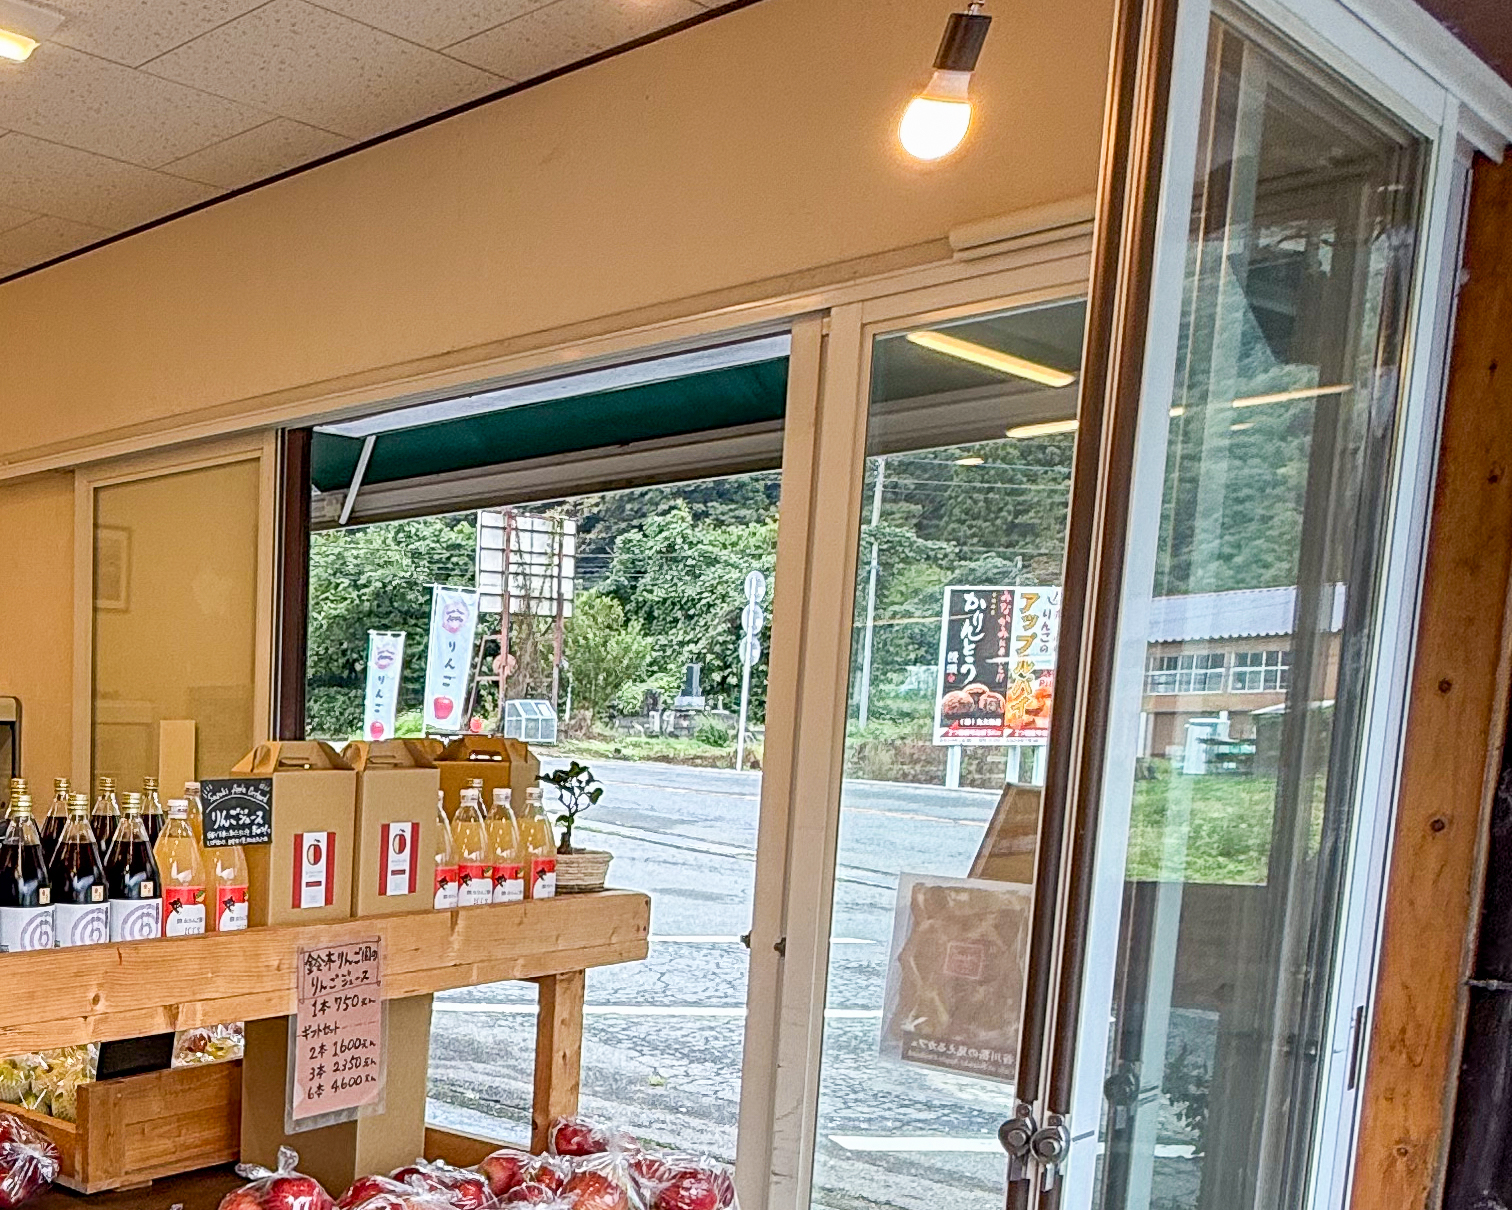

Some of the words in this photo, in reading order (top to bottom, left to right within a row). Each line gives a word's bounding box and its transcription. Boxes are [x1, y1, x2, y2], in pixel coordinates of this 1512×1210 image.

[960, 591, 987, 685] かりんとう
[442, 641, 456, 687] りんご
[1011, 592, 1040, 718] アップルパイ
[374, 675, 386, 713] りんご
[211, 808, 264, 829] りんごジュース
[311, 969, 370, 997] りんごジュース
[311, 998, 331, 1018] 1本
[301, 1020, 340, 1040] ギフトセット
[308, 1042, 328, 1061] 2本
[308, 1063, 327, 1082] 3本
[307, 1082, 325, 1100] 6本
